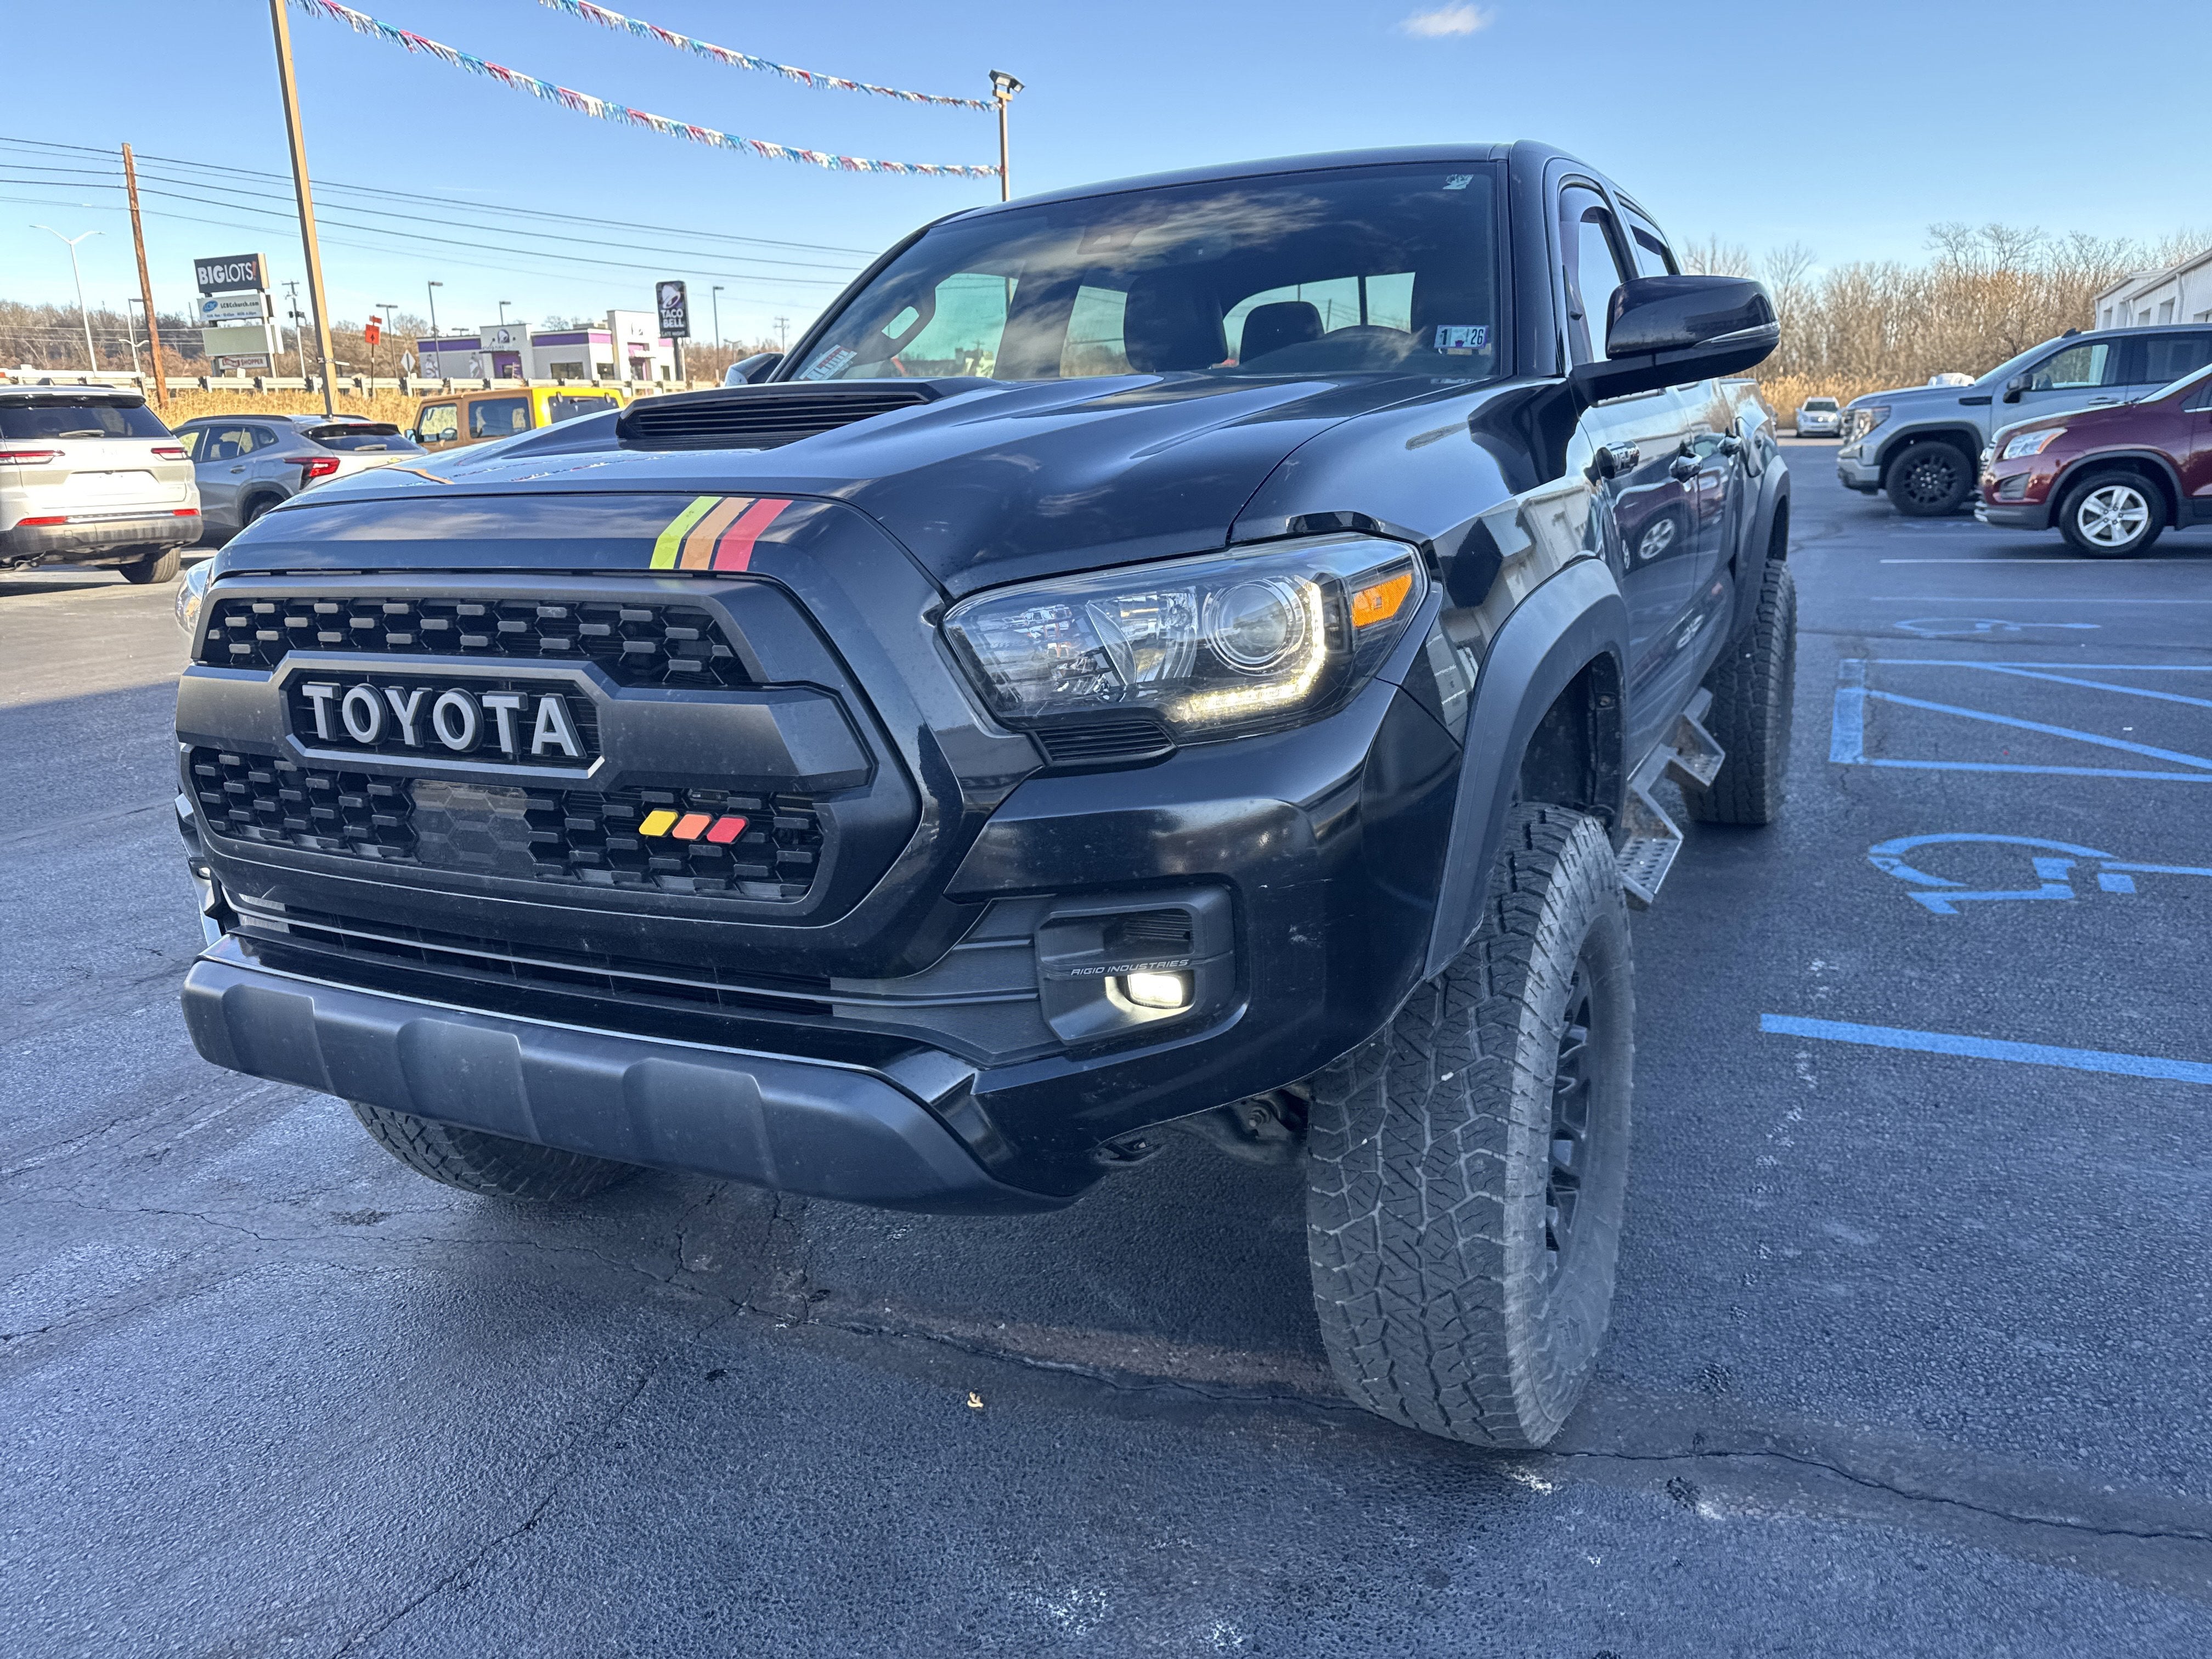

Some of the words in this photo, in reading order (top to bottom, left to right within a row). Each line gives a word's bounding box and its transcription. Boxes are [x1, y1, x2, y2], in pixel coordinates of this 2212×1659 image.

[661, 308, 684, 319] TACO
[663, 319, 684, 328] BELL
[1471, 329, 1484, 345] 26
[302, 682, 585, 758] TOYOTA
[1071, 966, 1105, 976] RIGID
[1107, 959, 1189, 973] INDUSTRIES
